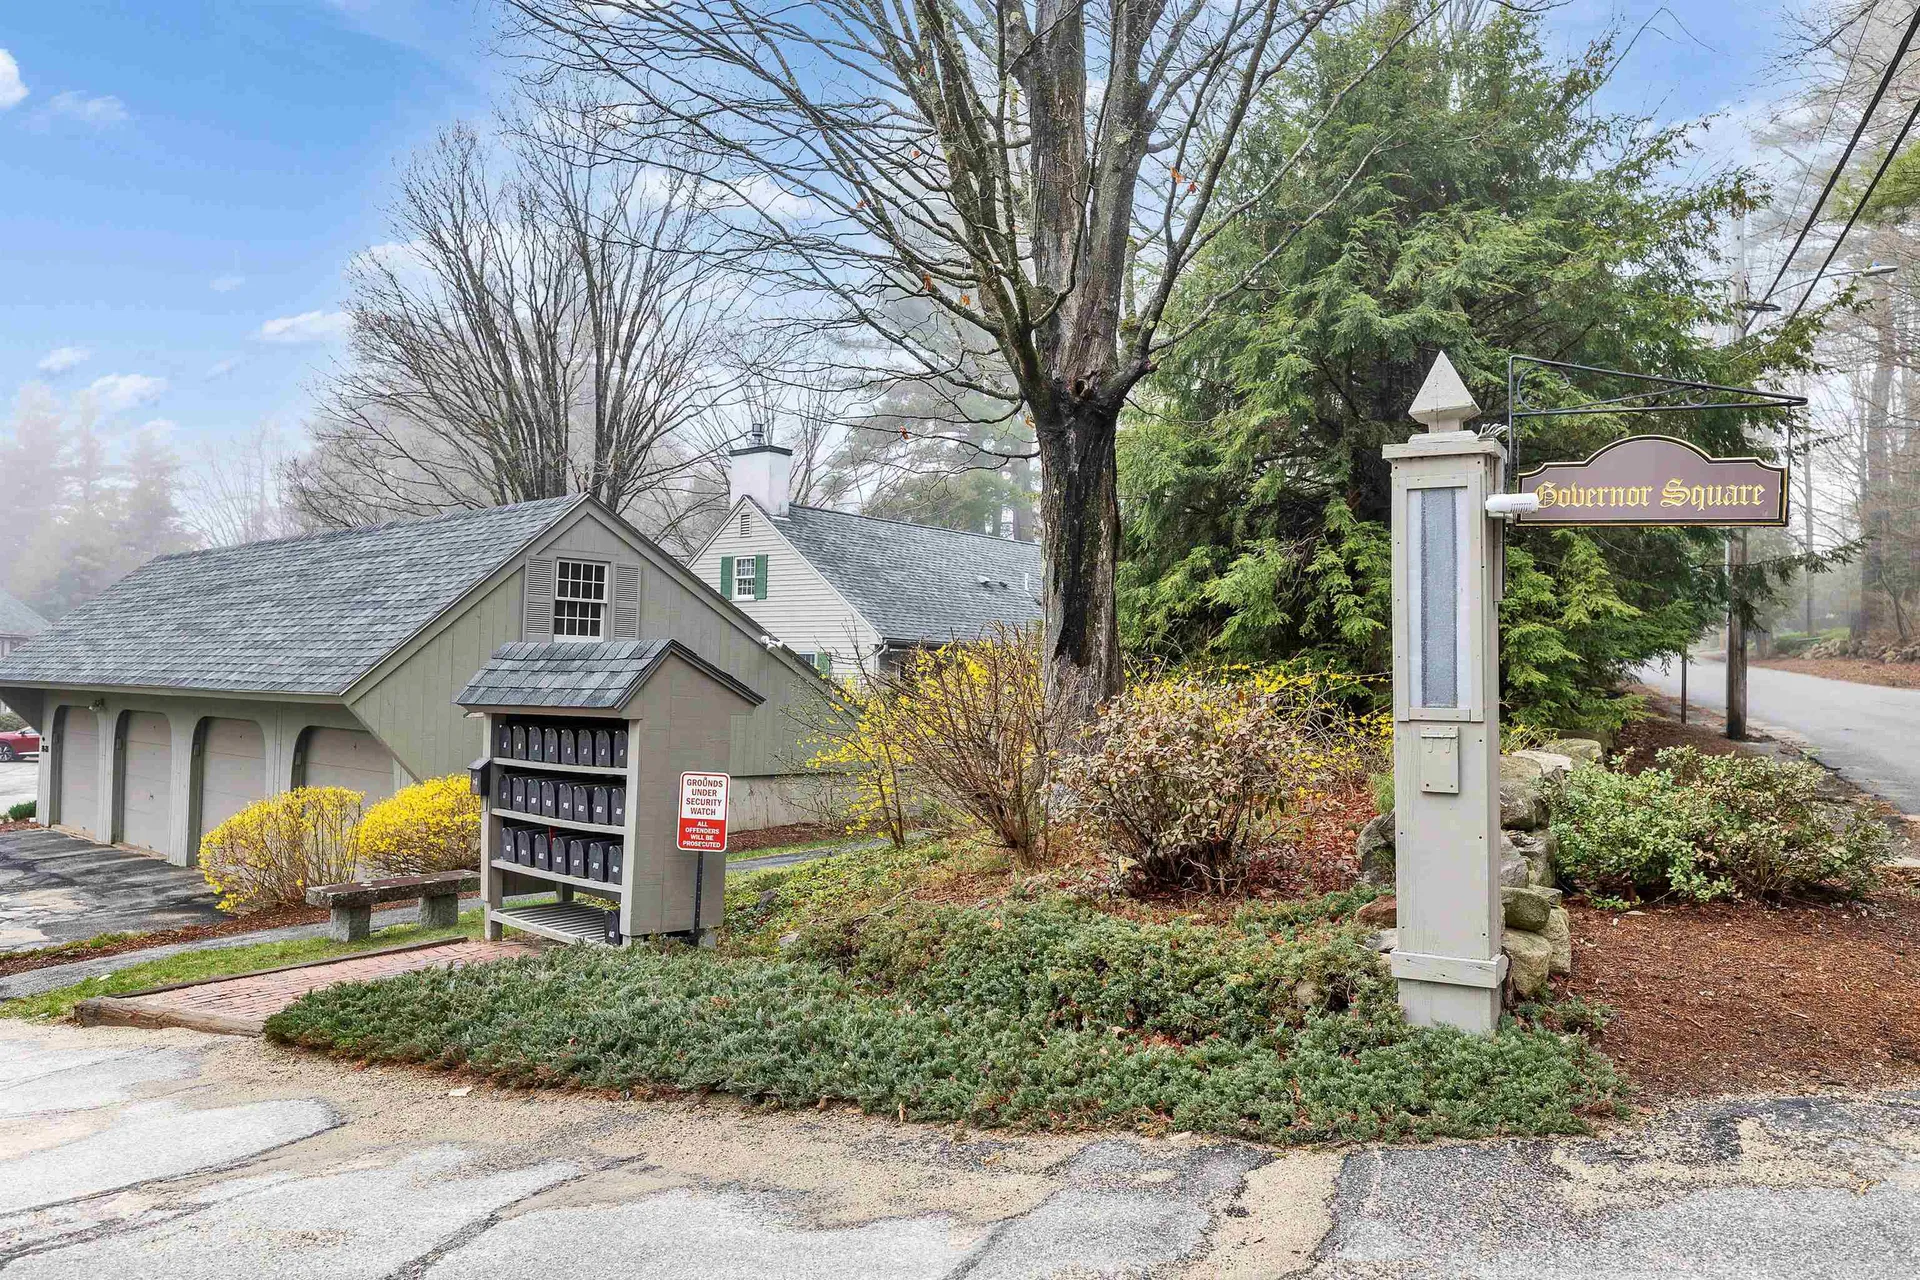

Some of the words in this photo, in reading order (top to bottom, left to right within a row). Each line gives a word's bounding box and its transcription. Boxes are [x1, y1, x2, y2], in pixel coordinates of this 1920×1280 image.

[1536, 480, 1653, 509] Governor
[1660, 478, 1765, 510] Square
[686, 778, 723, 788] GROUNDS
[686, 798, 722, 806] SECURITY
[690, 807, 716, 816] WATCH
